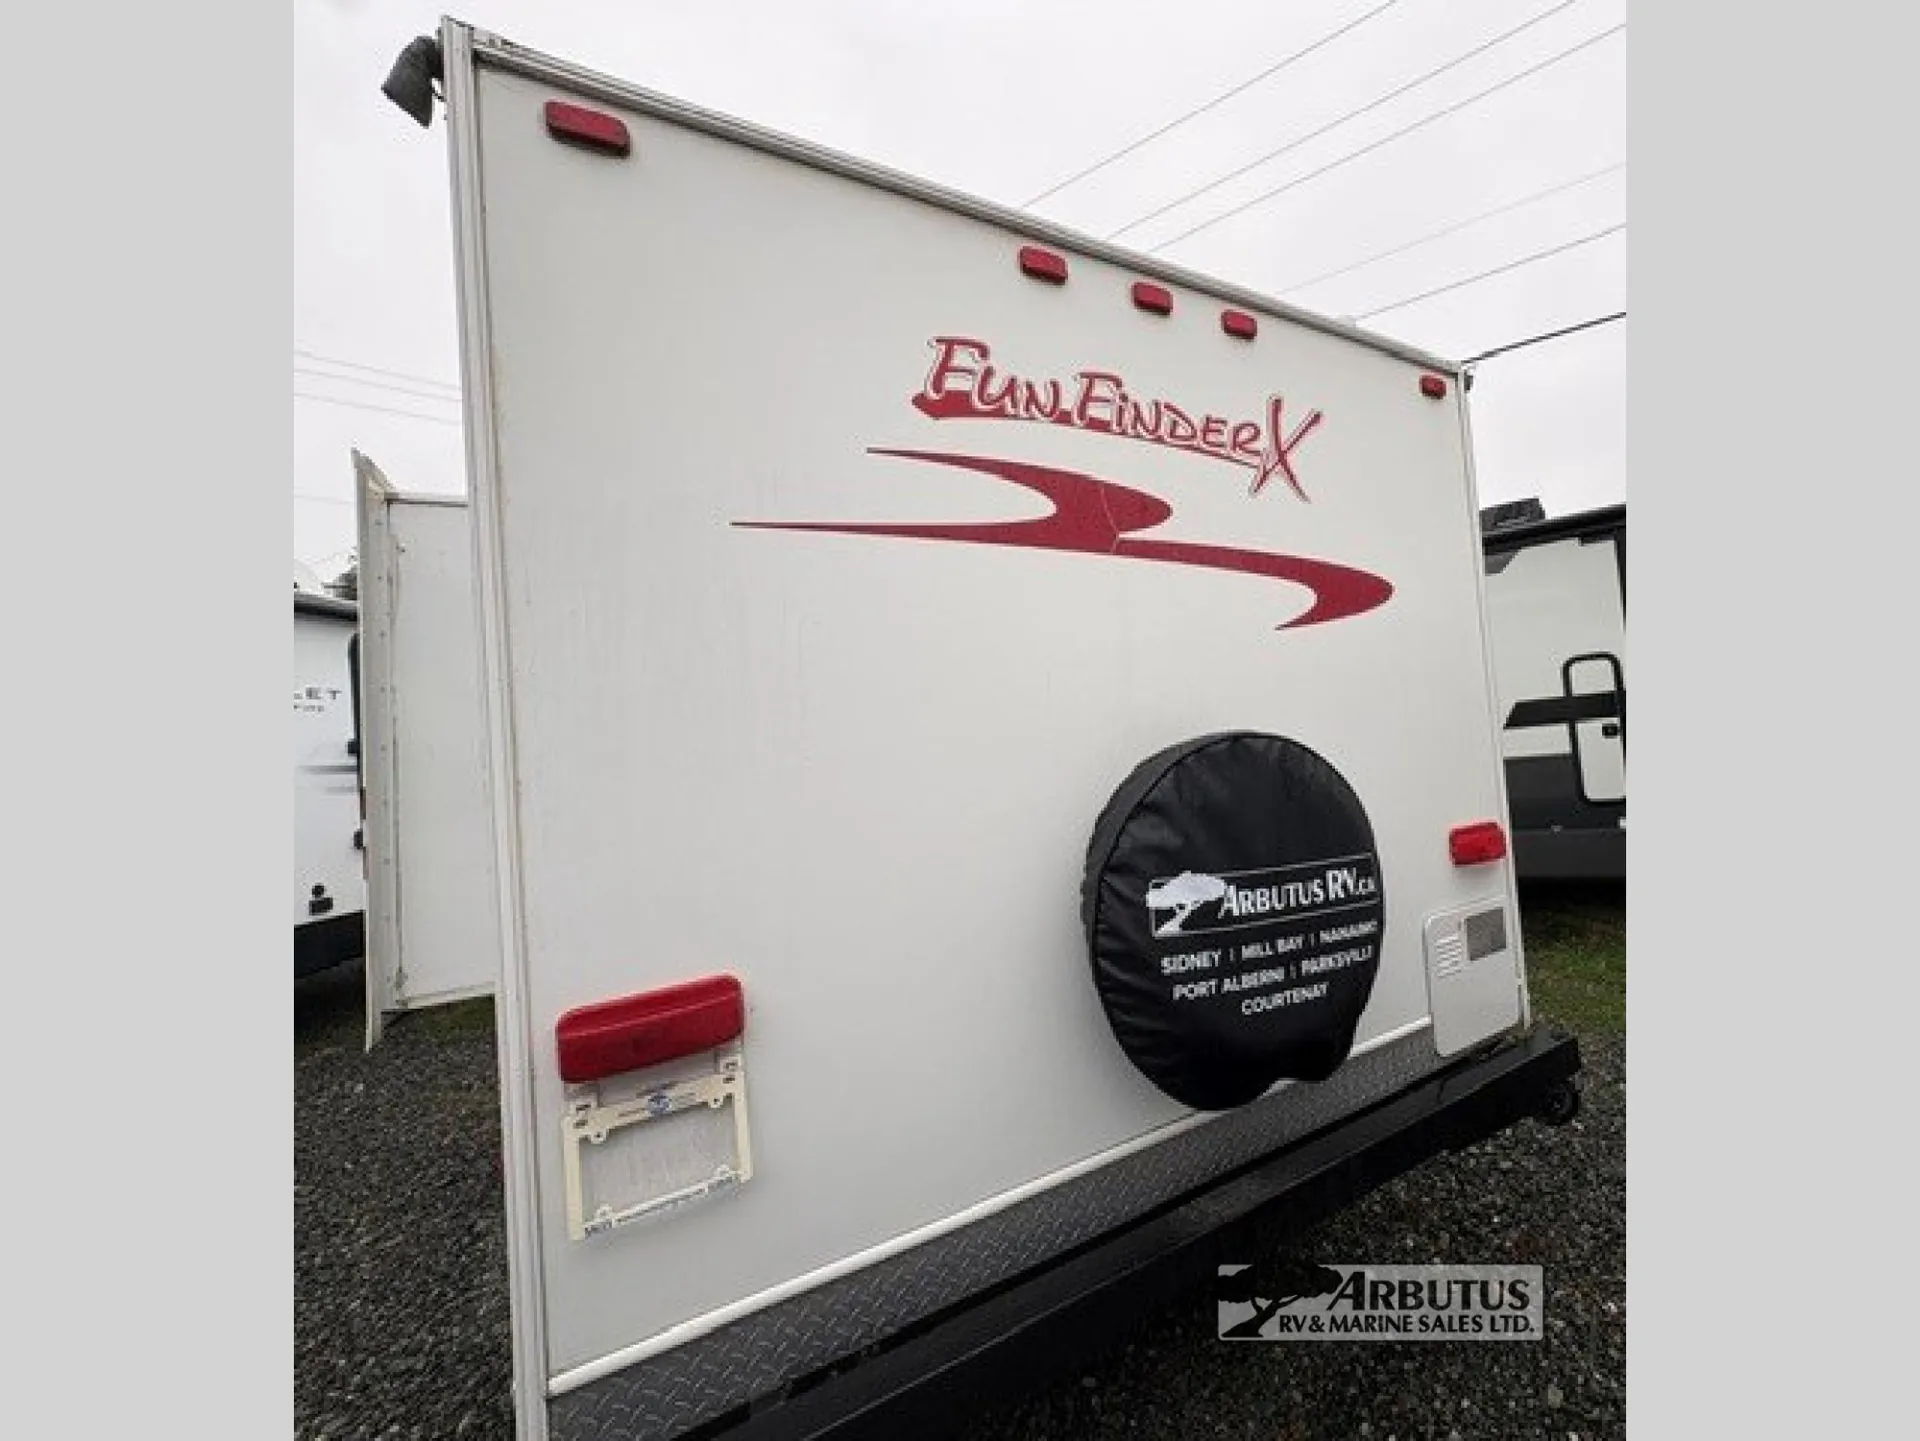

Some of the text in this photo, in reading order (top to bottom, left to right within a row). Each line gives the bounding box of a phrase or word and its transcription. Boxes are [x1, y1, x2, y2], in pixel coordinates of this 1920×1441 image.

[928, 337, 1060, 420] FUN
[1247, 393, 1322, 503] X
[1218, 881, 1323, 918] ARBUTUS
[1161, 951, 1221, 975] SIDNEY
[1241, 941, 1273, 960] MILL
[1276, 935, 1304, 953] BAY
[1173, 979, 1218, 1001] PORT
[1221, 967, 1285, 993] ALBERNI
[1241, 982, 1329, 1014] COURTENAY
